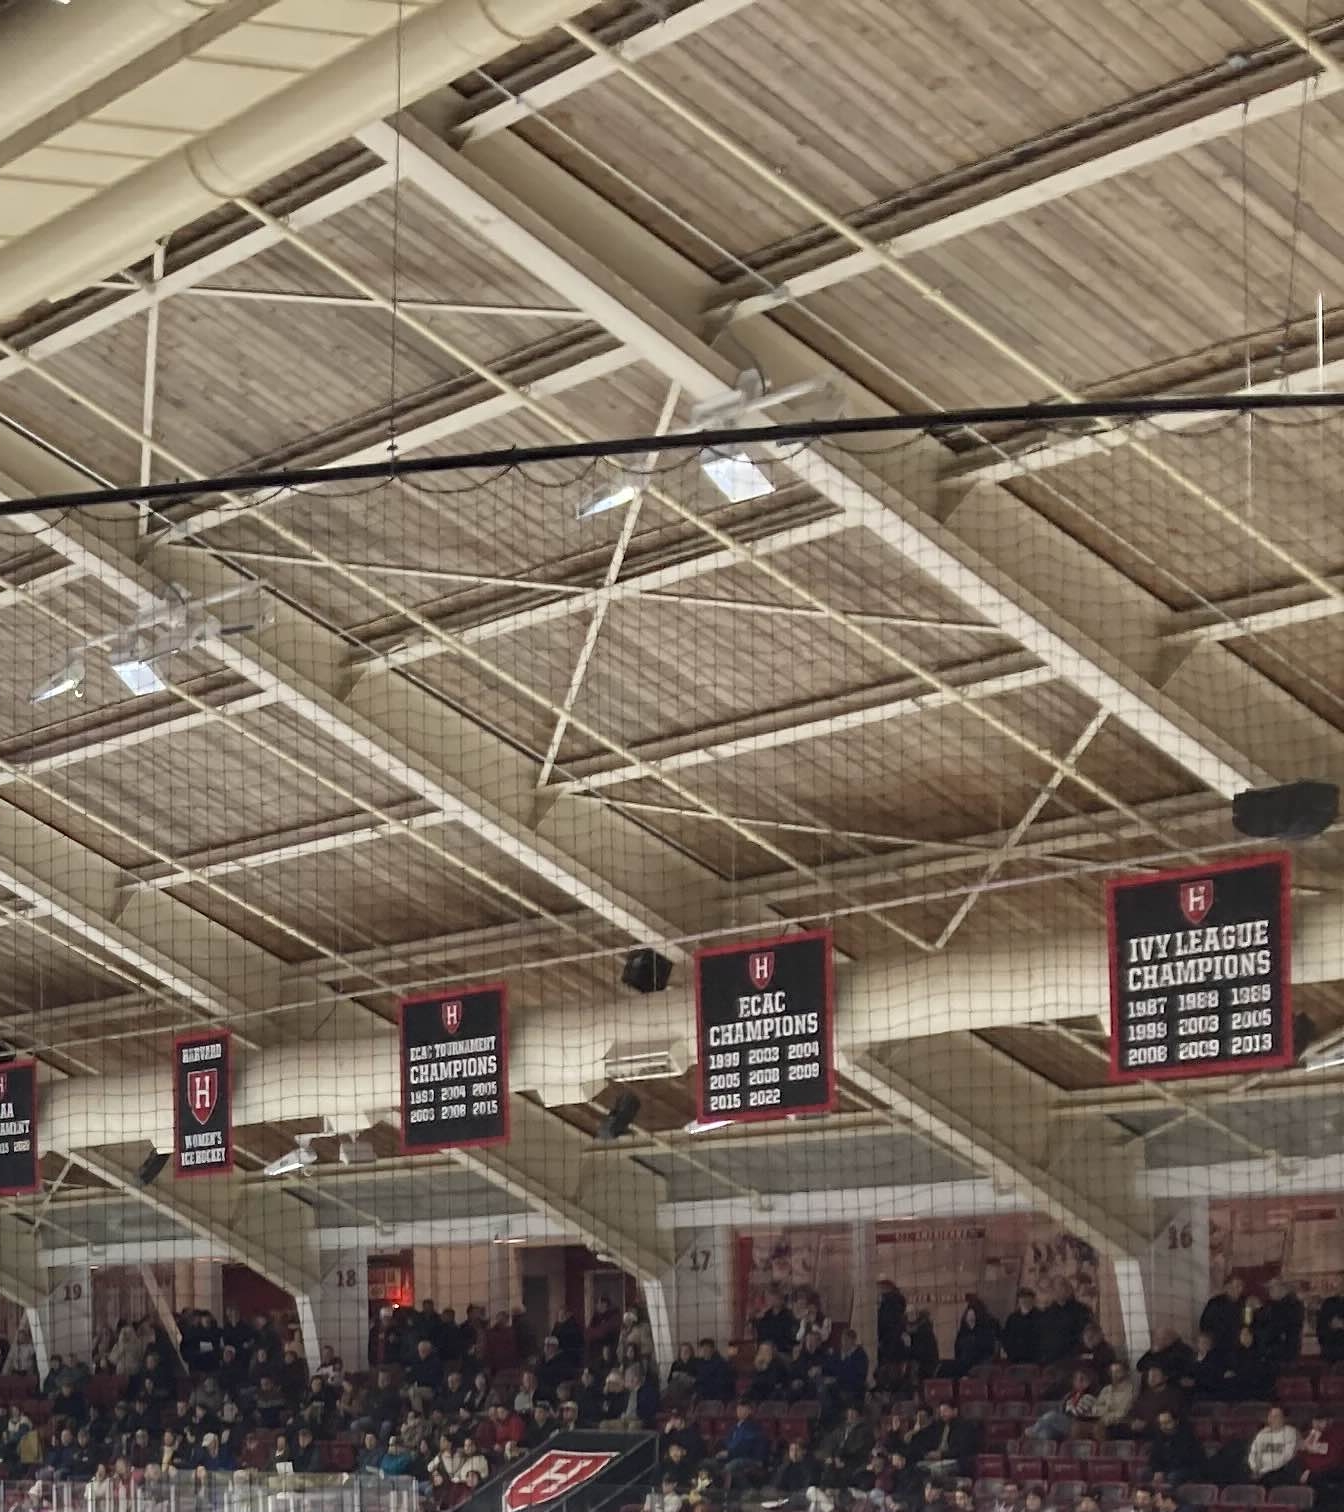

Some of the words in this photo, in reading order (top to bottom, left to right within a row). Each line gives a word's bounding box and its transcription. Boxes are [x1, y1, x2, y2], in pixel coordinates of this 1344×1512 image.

[1189, 886, 1205, 912] H
[1129, 934, 1171, 963] IVY
[1175, 920, 1269, 956] LEAGUE
[755, 958, 768, 979] H
[1128, 950, 1271, 992] CHAMPIONS
[447, 1005, 457, 1025] H
[738, 991, 786, 1018] ECAC
[1128, 997, 1167, 1019] 1987
[710, 1013, 819, 1047] CHAMPIONS
[1178, 1015, 1219, 1036] 2003
[1232, 1009, 1272, 1030] 2005
[182, 1044, 221, 1064] HARVARD
[410, 1046, 432, 1061] ECAC
[434, 1036, 496, 1058] TOURNAMENT
[748, 1047, 780, 1064] 2003
[788, 1042, 819, 1059] 2004
[1179, 1040, 1220, 1060] 2009
[1232, 1034, 1272, 1055] 2013
[410, 1055, 497, 1084] CHAMPIONS
[195, 1075, 210, 1109] H
[710, 1073, 740, 1090] 2005
[711, 1093, 741, 1111] 2015
[750, 1089, 781, 1106] 2022
[185, 1131, 222, 1149] WOMEN'S
[181, 1151, 194, 1166] ICE
[195, 1147, 226, 1165] HOCKEY
[1168, 1222, 1193, 1249] 16
[689, 1250, 711, 1271] 17
[336, 1270, 356, 1287] 18
[64, 1283, 82, 1300] 19
[518, 1458, 593, 1494] H
